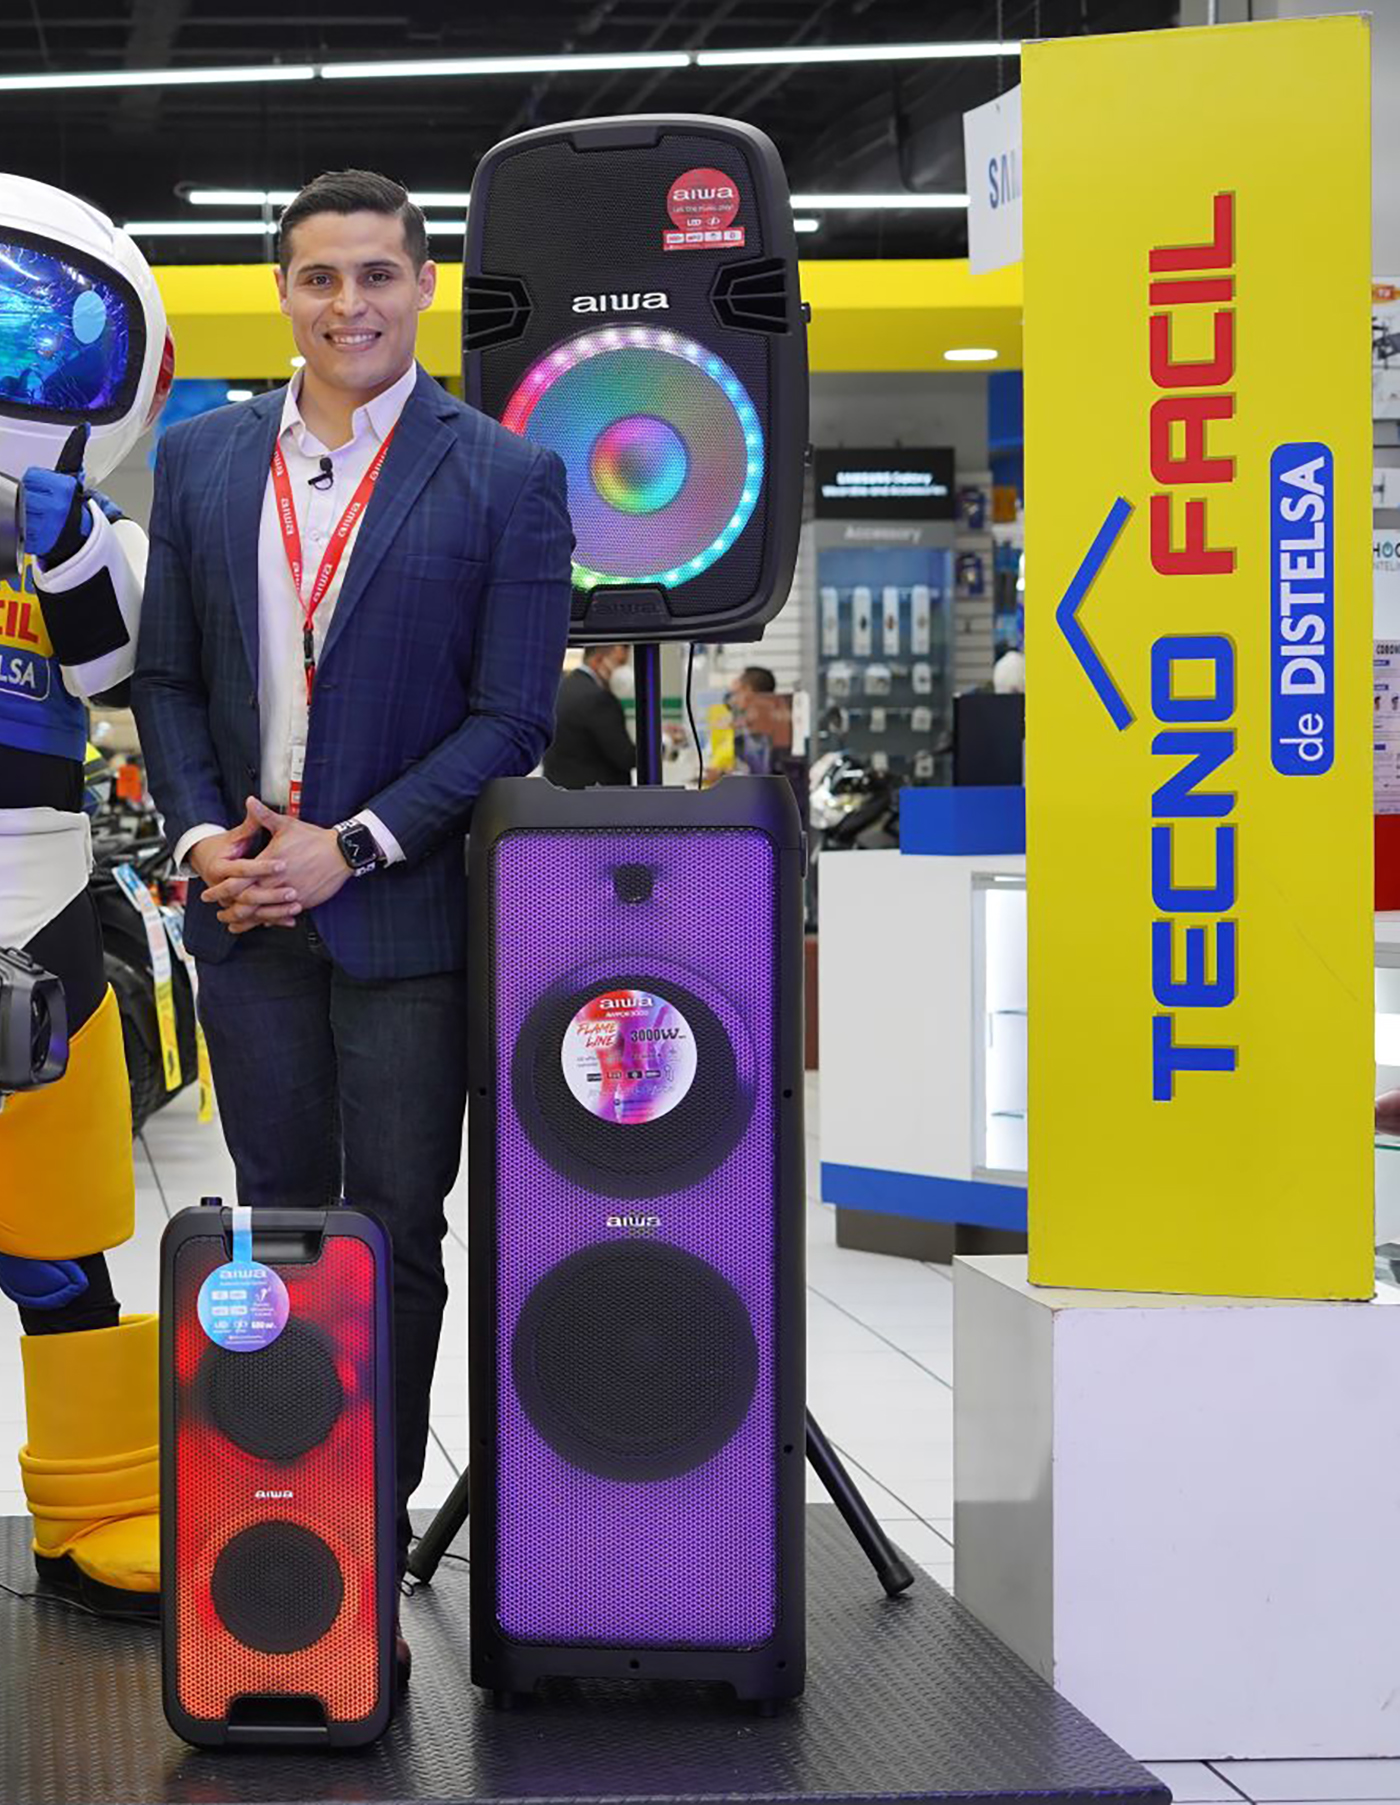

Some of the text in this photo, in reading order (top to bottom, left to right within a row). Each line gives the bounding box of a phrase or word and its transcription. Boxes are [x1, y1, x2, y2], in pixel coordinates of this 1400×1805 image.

[672, 187, 734, 201] aiwa
[571, 291, 670, 313] aiwa
[1149, 190, 1237, 577] FACIL
[281, 497, 295, 536] aiwa
[337, 501, 362, 538] aiwa
[844, 525, 922, 544] Accessory
[312, 563, 334, 603] aiwa
[1279, 455, 1326, 763] de DISTELSA
[1151, 634, 1237, 1101] TECNO
[600, 997, 654, 1010] aiwa
[577, 1022, 617, 1034] FLAME
[630, 1027, 680, 1043] 3000W
[585, 1034, 614, 1048] LINE
[606, 1215, 661, 1228] aiwa
[219, 1269, 268, 1280] aiwa
[254, 1490, 294, 1498] aiwa
